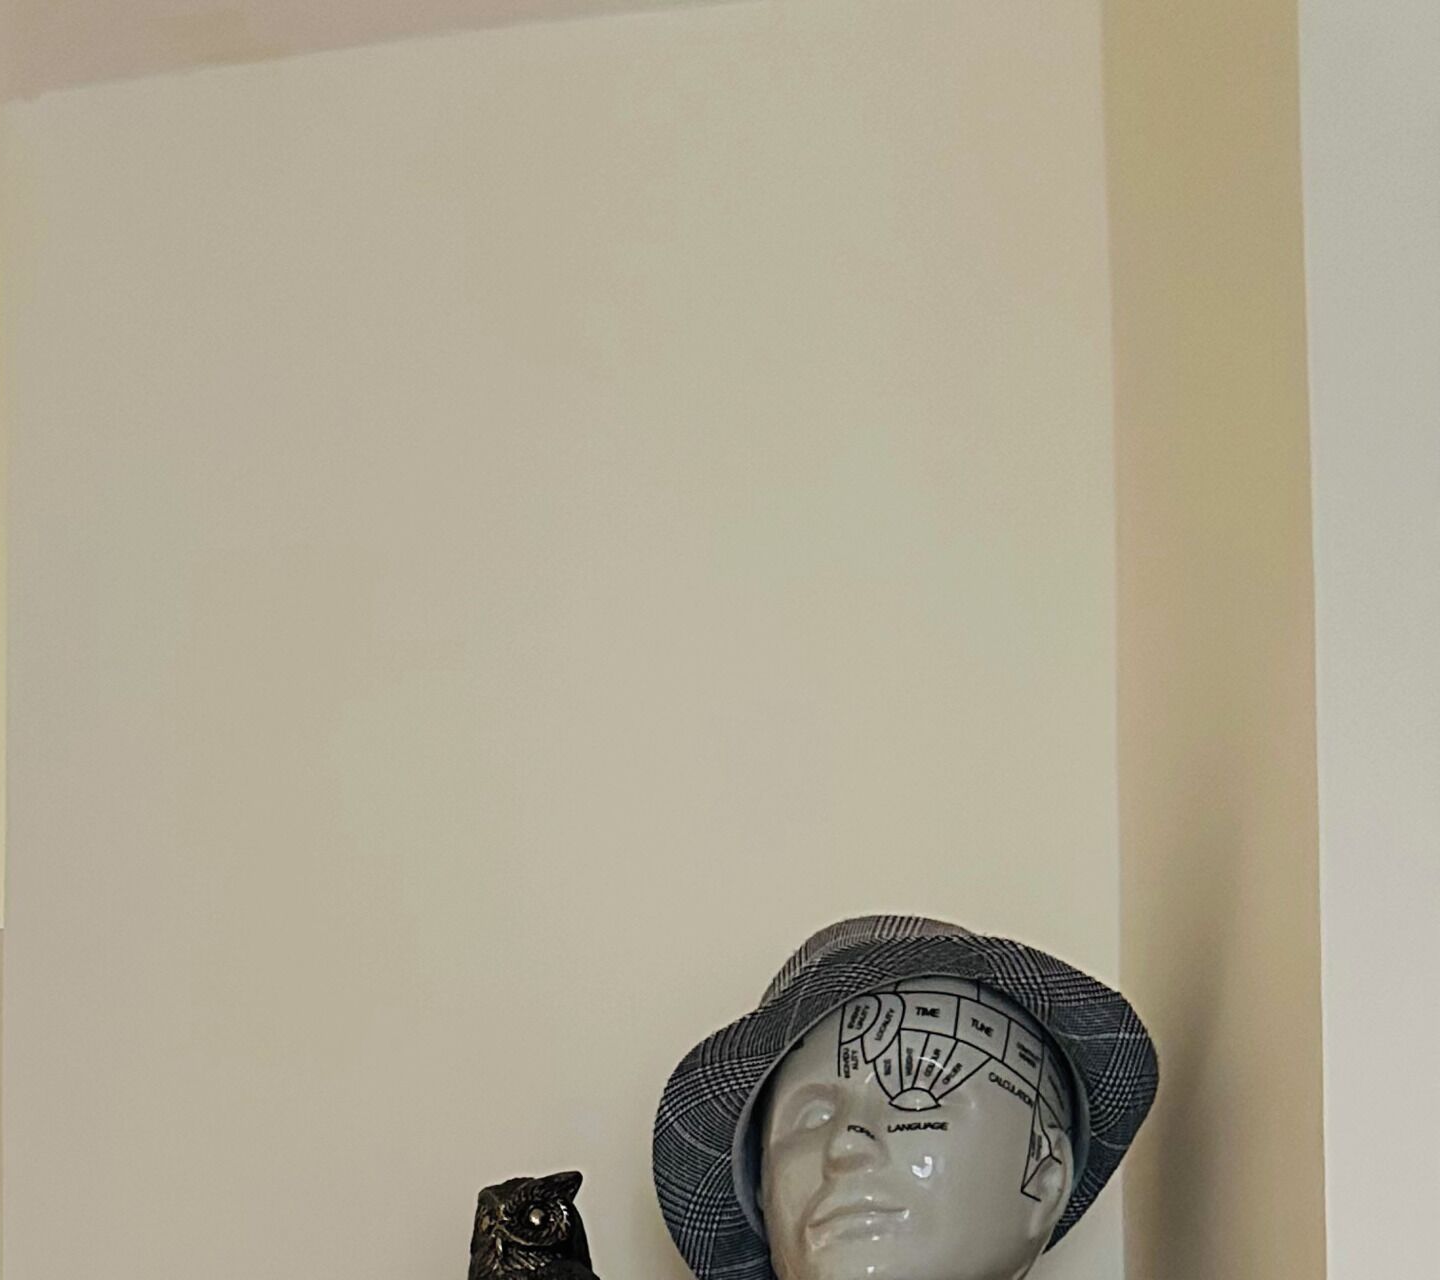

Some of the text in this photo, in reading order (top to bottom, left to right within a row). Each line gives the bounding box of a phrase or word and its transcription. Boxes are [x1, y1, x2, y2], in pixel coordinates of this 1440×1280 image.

[916, 1006, 940, 1018] TIME
[971, 1017, 994, 1037] TUNE
[887, 1122, 948, 1133] LANGUAGE
